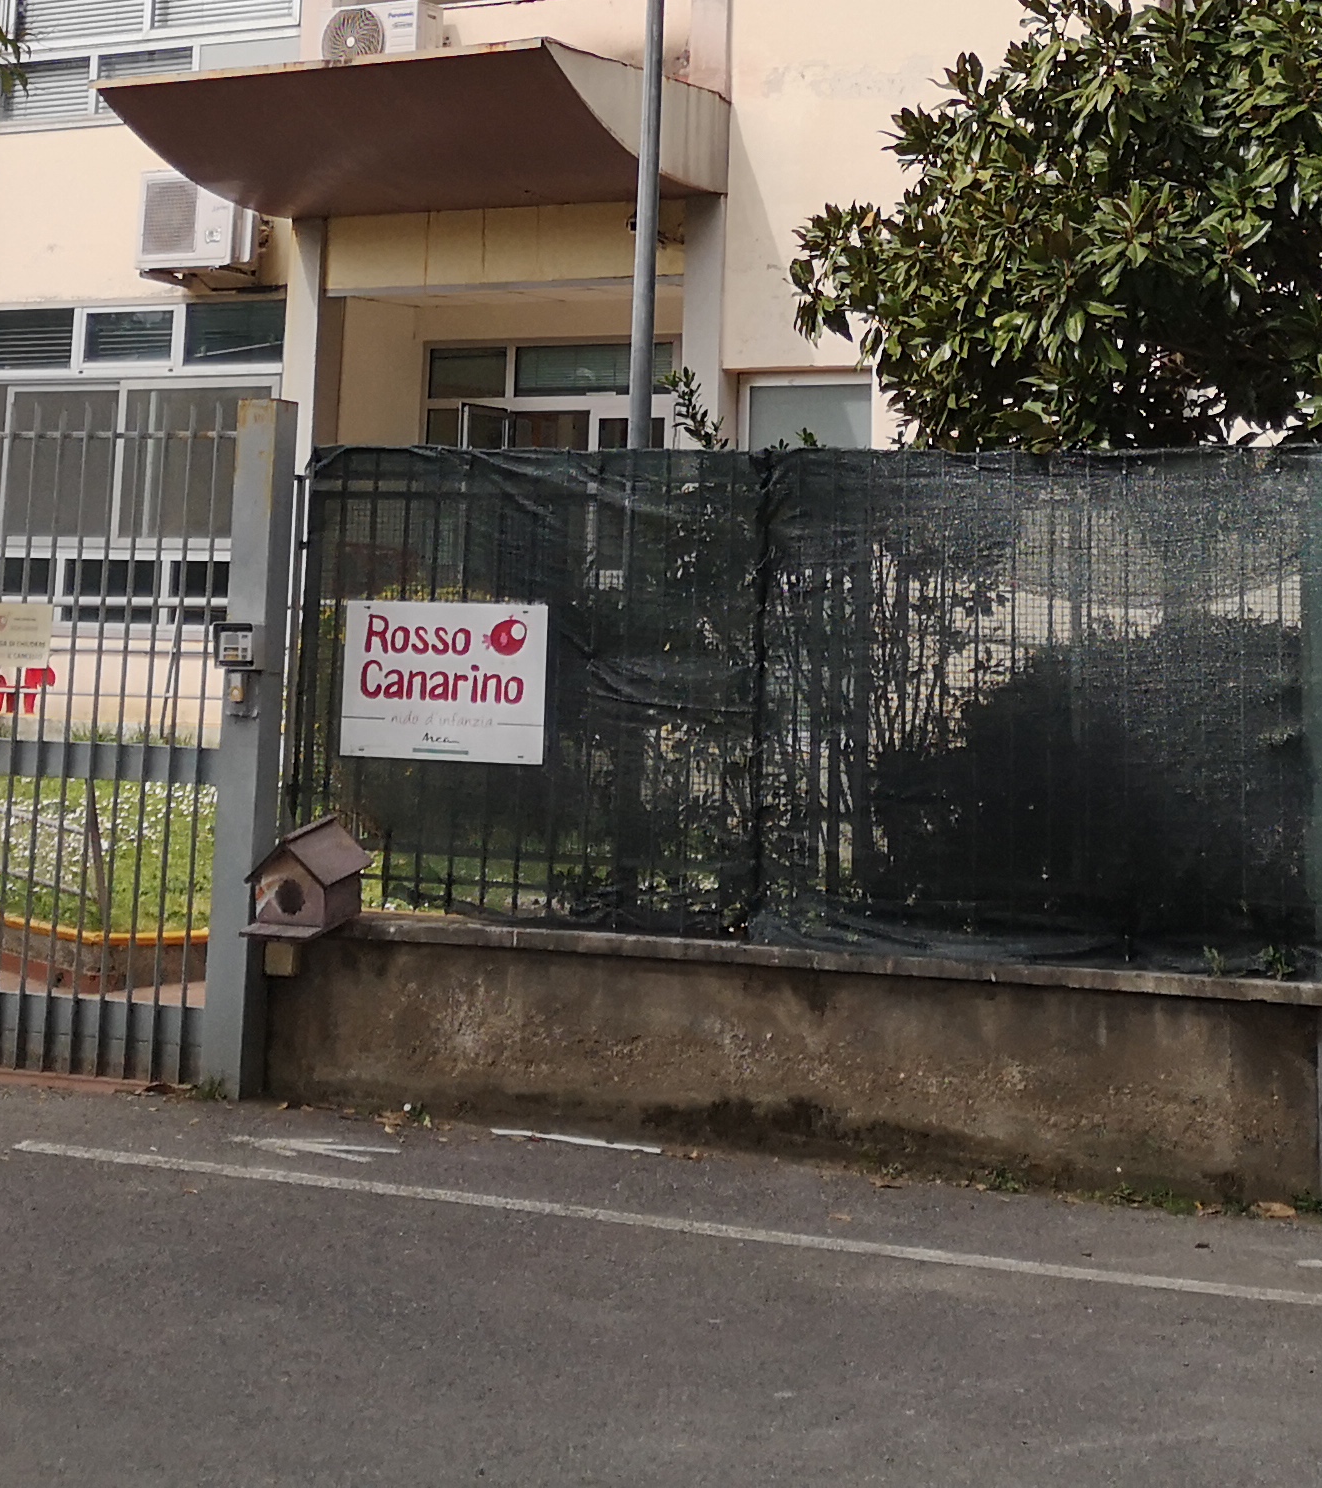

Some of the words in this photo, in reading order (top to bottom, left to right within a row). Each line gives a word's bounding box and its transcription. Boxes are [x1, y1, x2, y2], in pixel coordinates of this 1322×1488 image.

[364, 613, 472, 656] Rosso
[360, 659, 525, 705] Canarino
[390, 711, 419, 726] nido
